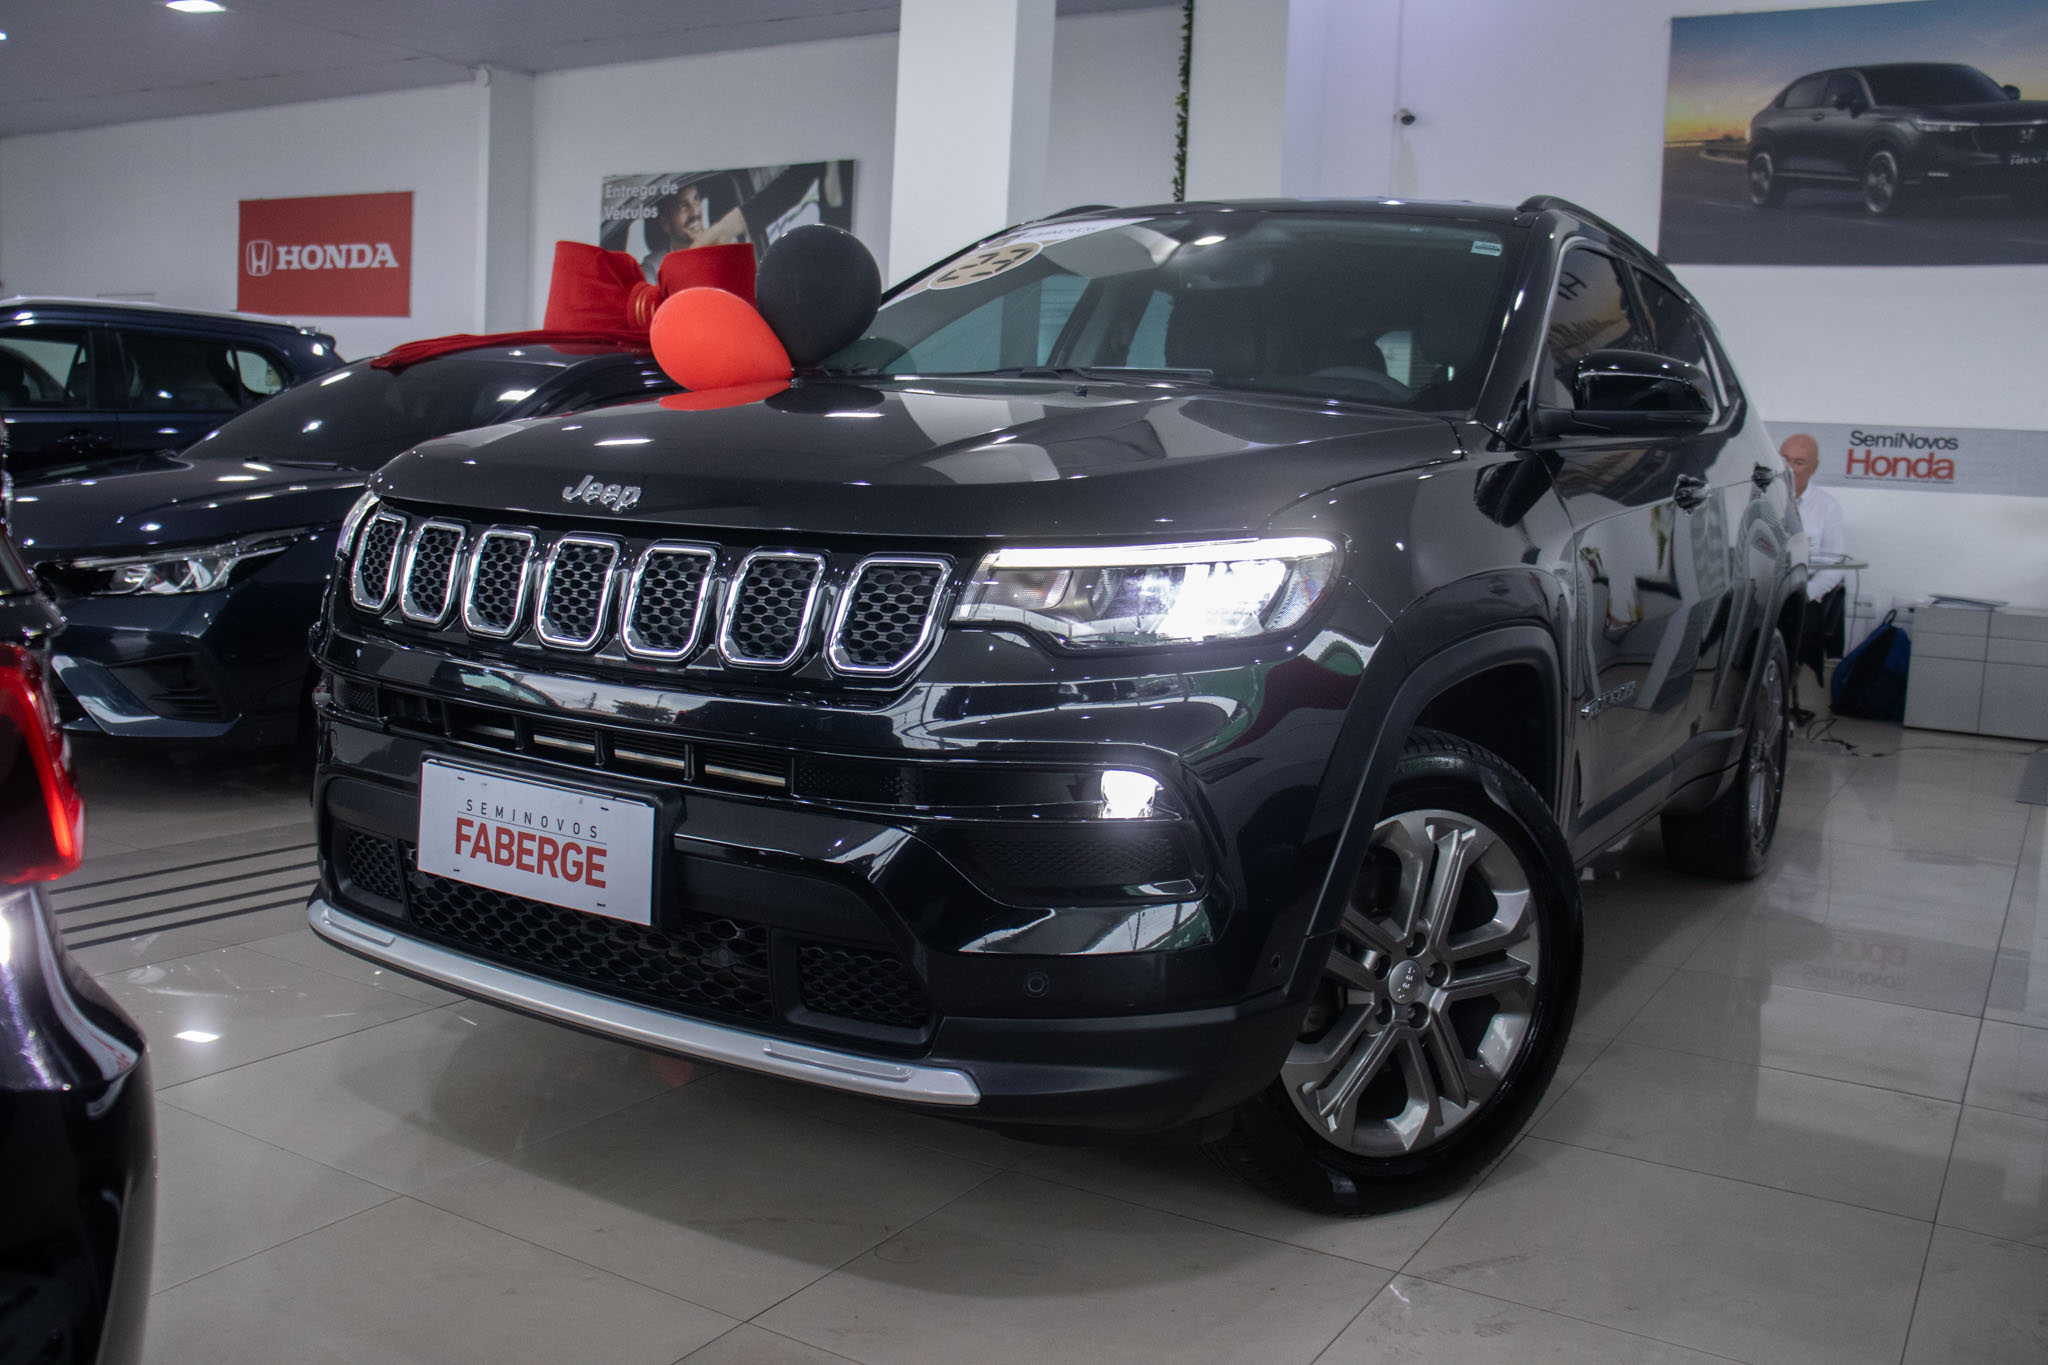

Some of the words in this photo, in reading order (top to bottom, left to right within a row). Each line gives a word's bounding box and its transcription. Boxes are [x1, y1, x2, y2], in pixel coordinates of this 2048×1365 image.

[605, 184, 657, 201] Entrega
[661, 181, 679, 195] de
[276, 243, 398, 270] HONDA
[1849, 430, 1959, 450] SemiNovos
[1846, 448, 1955, 480] Honda
[562, 474, 642, 512] Jeep
[466, 799, 598, 839] SEMINOVOS
[455, 816, 607, 889] FABERGE
